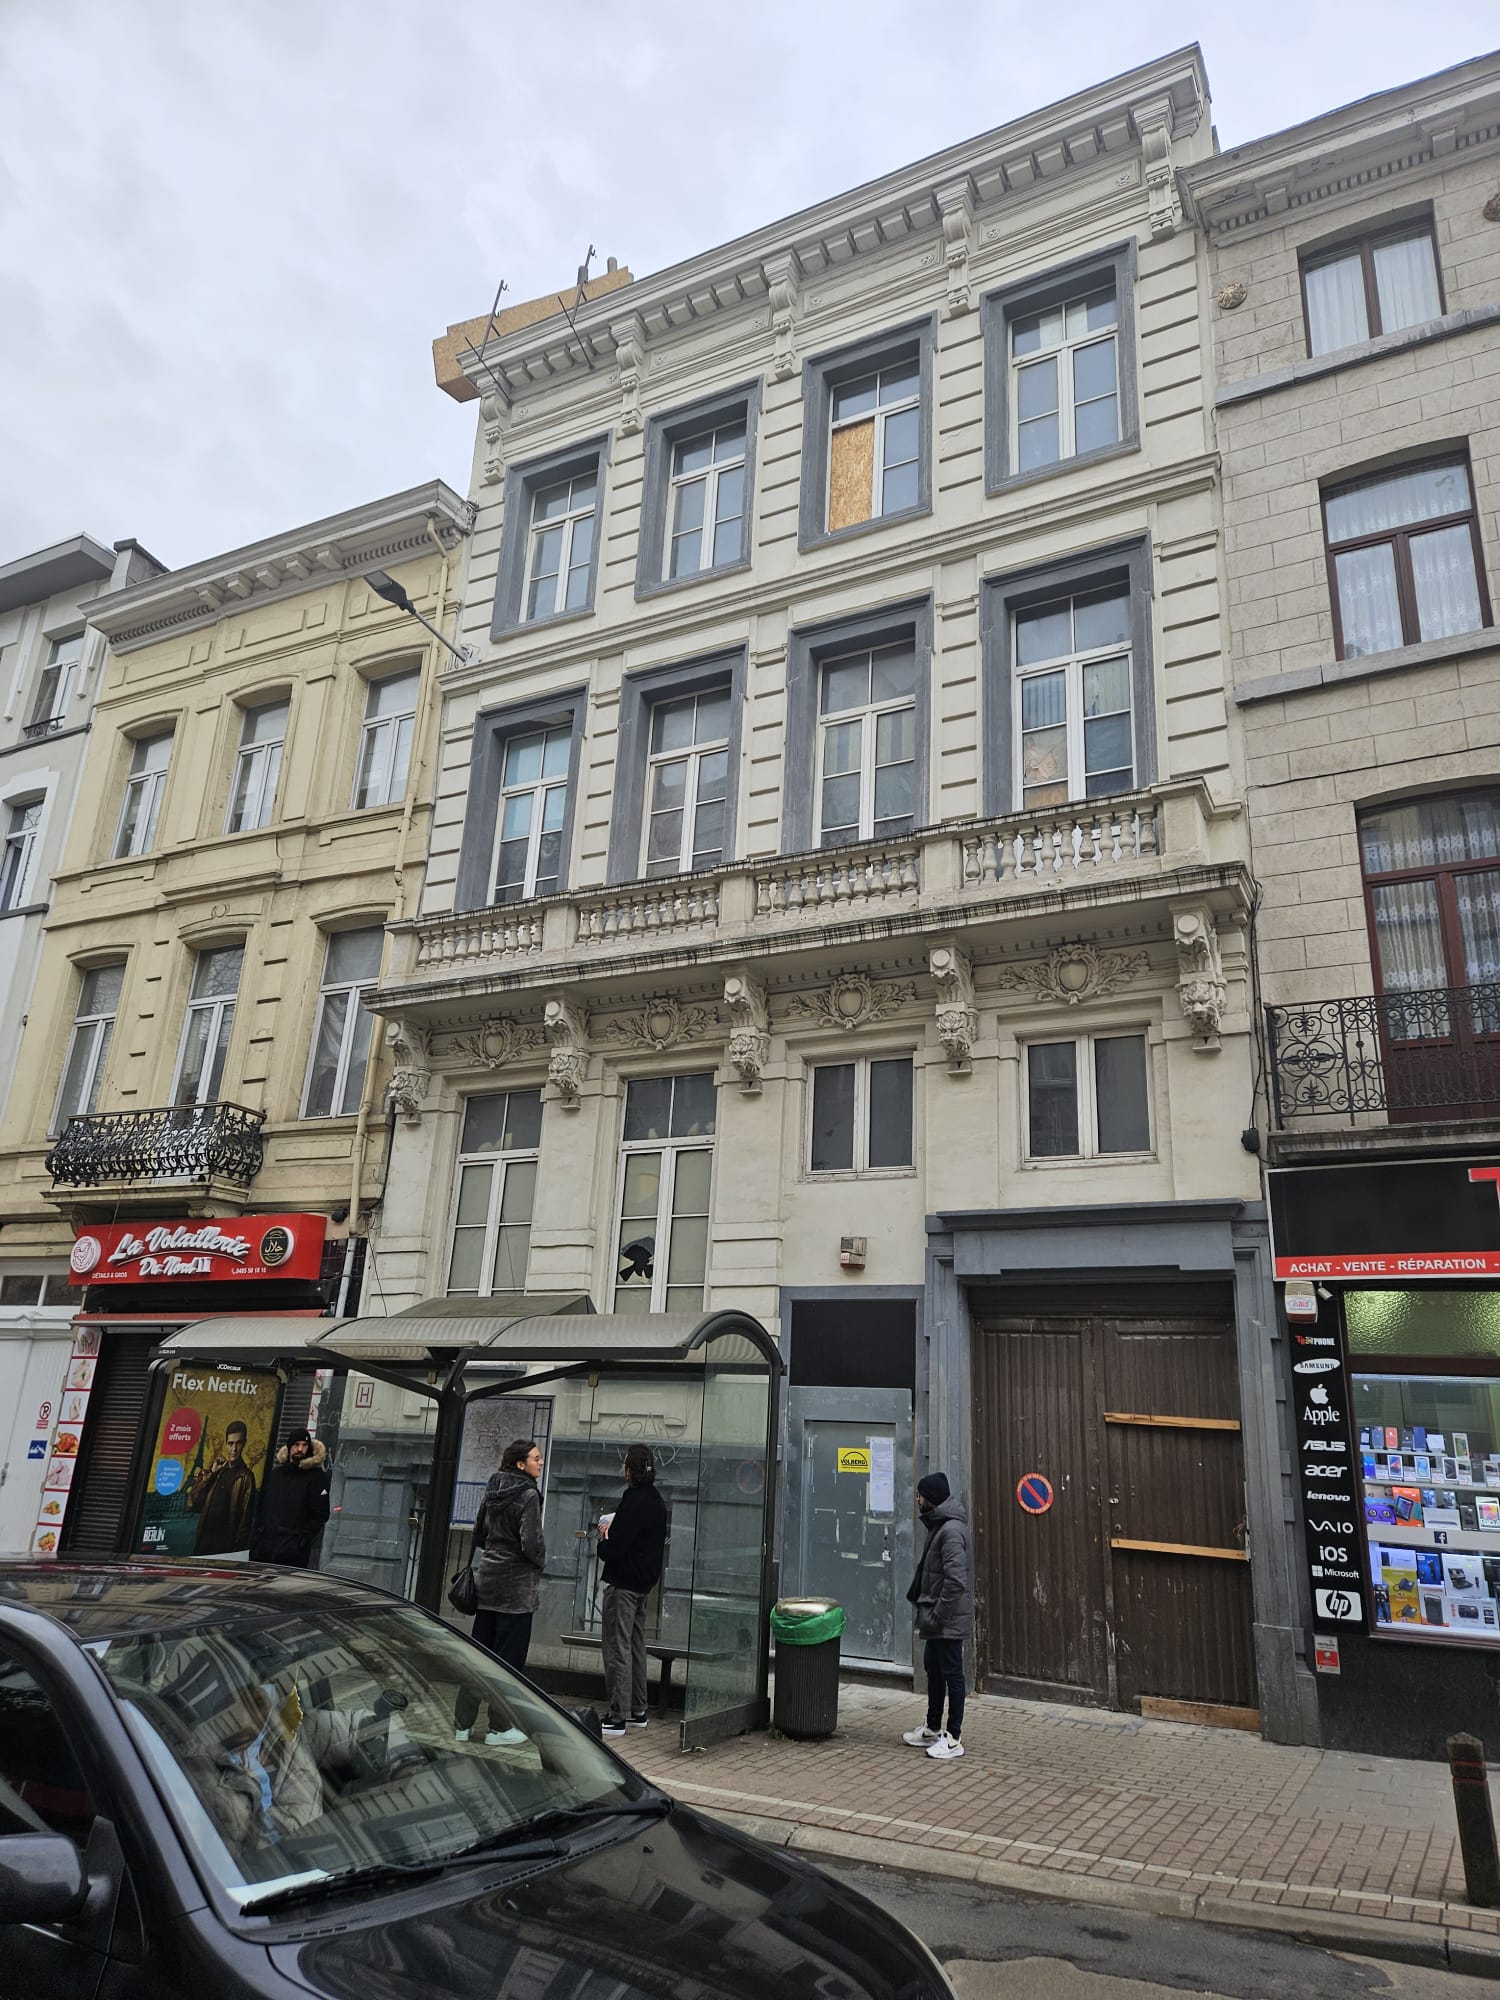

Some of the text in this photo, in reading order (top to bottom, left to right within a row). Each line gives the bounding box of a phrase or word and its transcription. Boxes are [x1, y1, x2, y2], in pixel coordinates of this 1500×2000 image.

[107, 1225, 251, 1263] La Volaillerie
[139, 1257, 164, 1276] Du
[163, 1255, 197, 1276] Nord
[1290, 1262, 1332, 1273] ACHAT
[1343, 1261, 1386, 1272] VENTE
[1398, 1258, 1486, 1270] RÉPARATION
[1300, 1362, 1335, 1370] SAMSUNG
[172, 1373, 258, 1394] Flex Netflix
[1303, 1405, 1340, 1425] Apple
[170, 1424, 191, 1432] 2 mois
[169, 1433, 191, 1441] offerts
[1303, 1440, 1346, 1451] ASUS
[1304, 1464, 1347, 1478] acer
[1308, 1519, 1354, 1534] VAIO
[1319, 1545, 1348, 1562] iOS
[1324, 1568, 1360, 1579] Microsoft
[1329, 1590, 1349, 1618] hp
